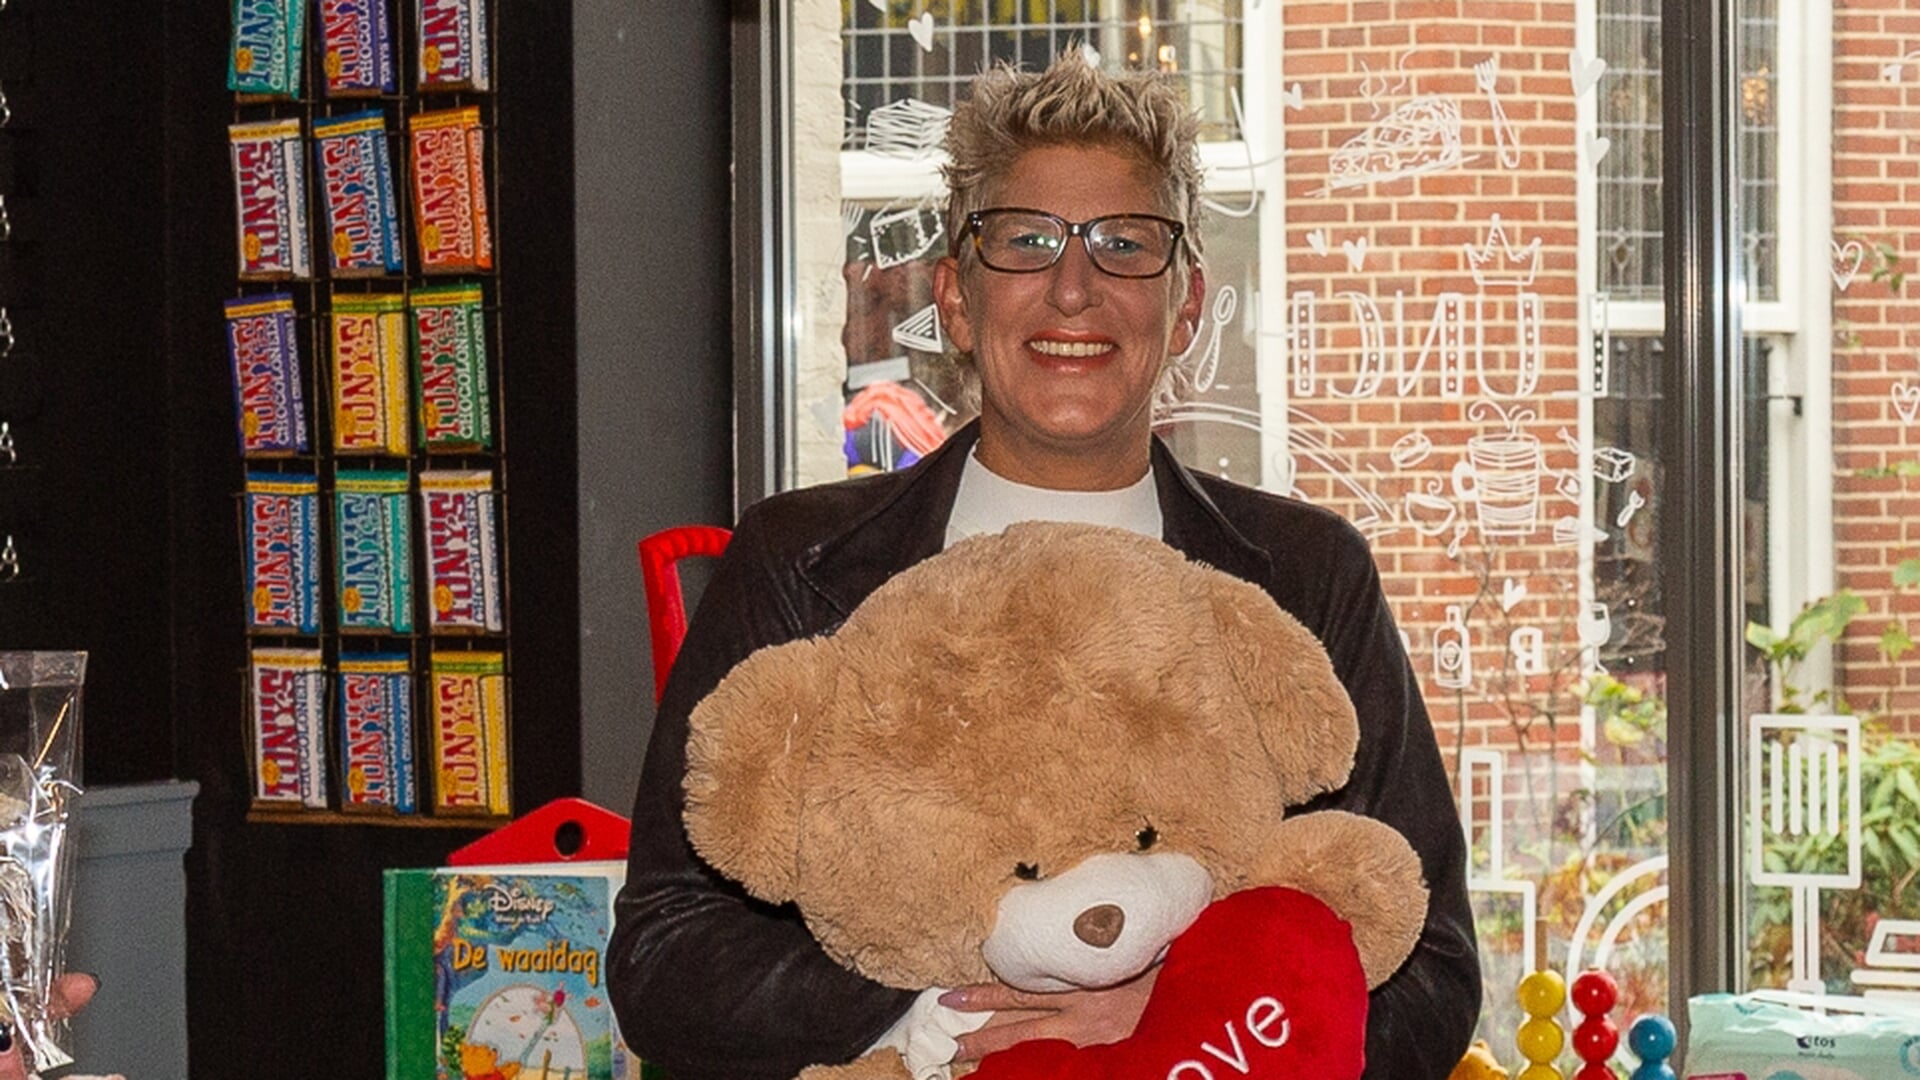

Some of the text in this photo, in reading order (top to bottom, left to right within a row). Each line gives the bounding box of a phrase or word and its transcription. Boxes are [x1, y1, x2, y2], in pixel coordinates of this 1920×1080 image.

[239, 141, 280, 271] TONY'S
[322, 137, 372, 269] TONY'S
[360, 135, 383, 265] CHOCOLONELY
[416, 128, 461, 263] TONY'S
[450, 127, 472, 258] CHOCOLONELY
[232, 318, 277, 449] TONY'S
[267, 314, 289, 445] CHOCOLONELY
[338, 317, 377, 446] TONY'S
[417, 308, 459, 441] TONY'S
[454, 306, 473, 439] CHOCOLONELY
[253, 495, 291, 624] TONY'S
[341, 494, 381, 625] TONY'S
[428, 493, 472, 623] TONY'S
[259, 669, 298, 797] TONY'S
[344, 675, 384, 803] TONY'S
[441, 677, 479, 806] TONY'S
[452, 938, 599, 986] De waaidag
[483, 884, 554, 918] Disney
